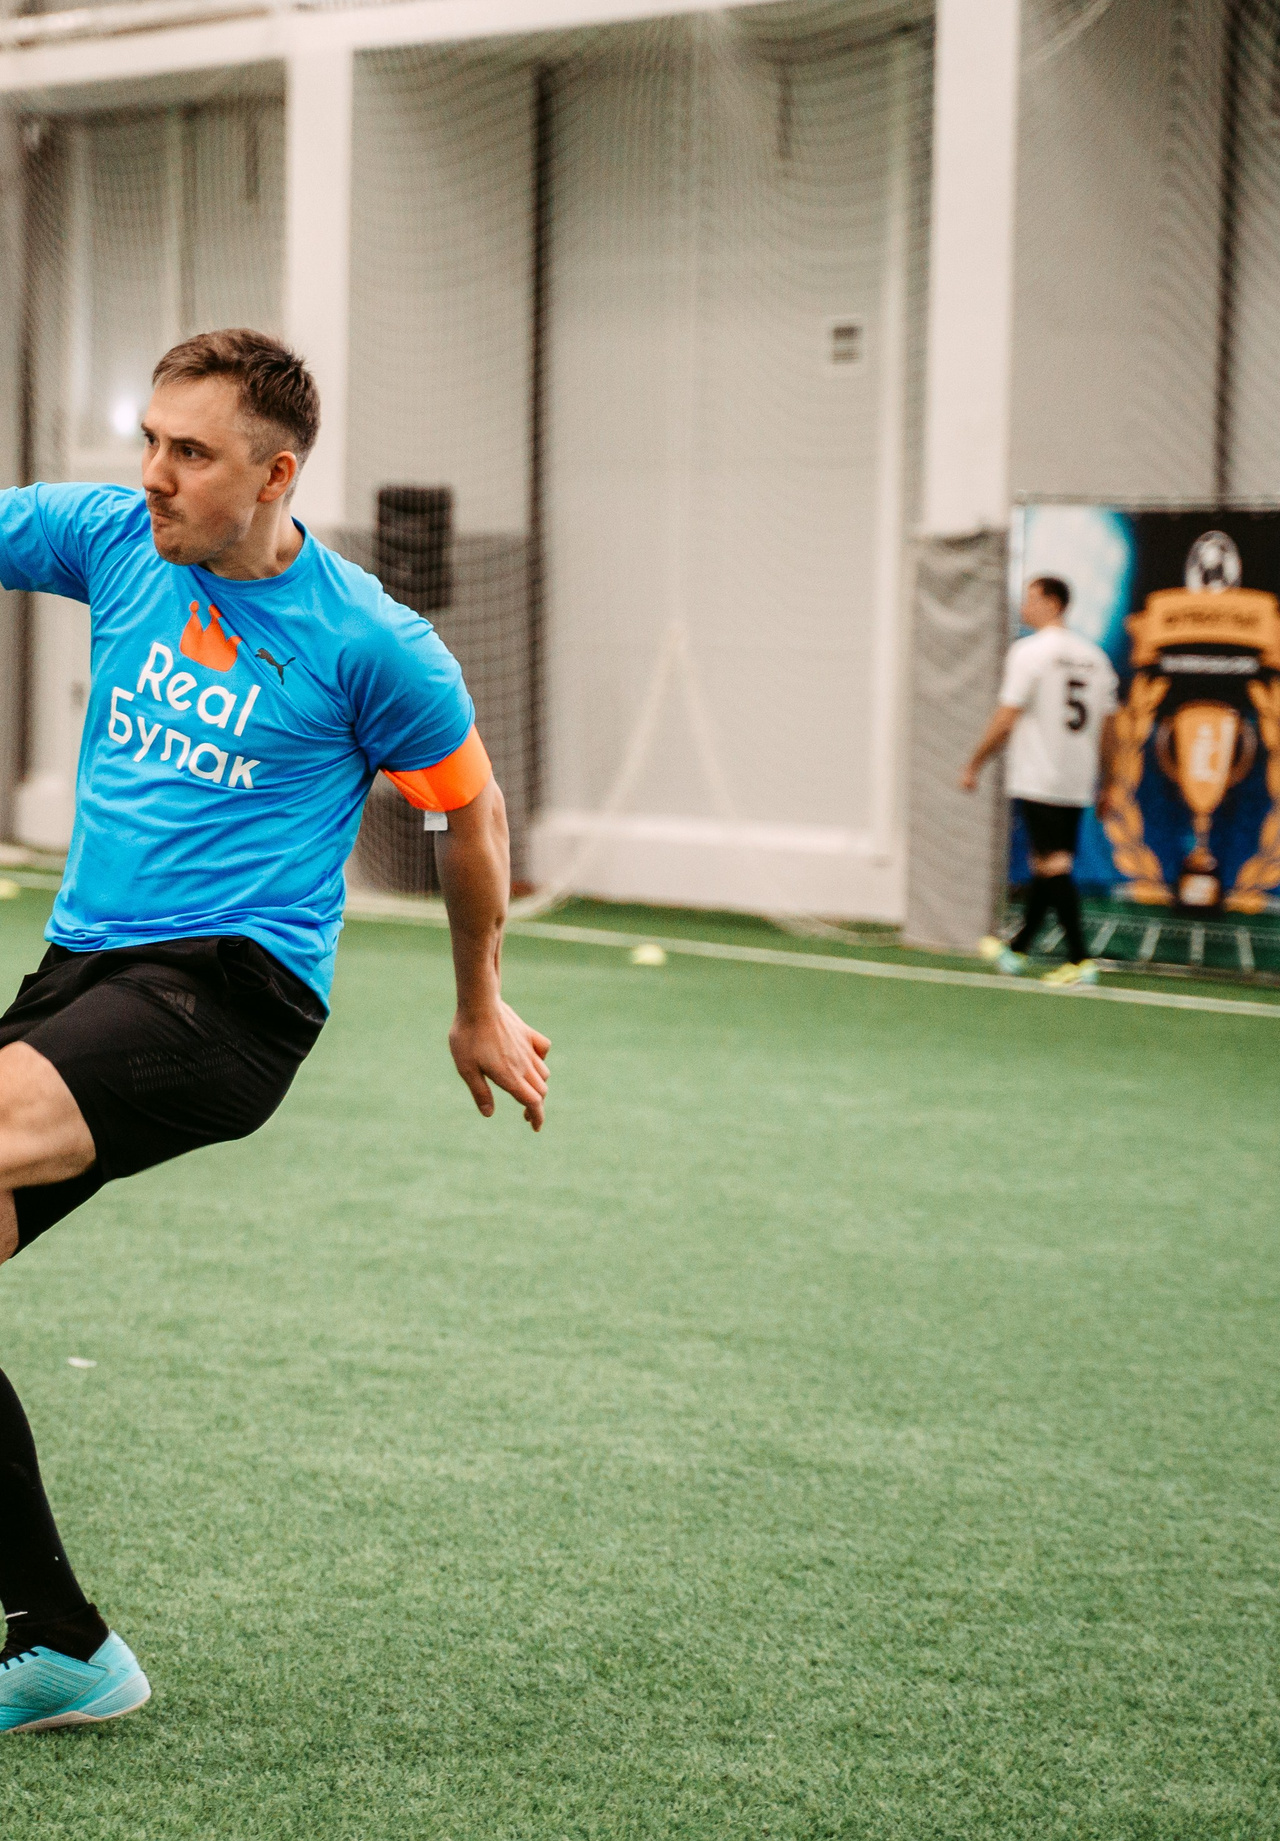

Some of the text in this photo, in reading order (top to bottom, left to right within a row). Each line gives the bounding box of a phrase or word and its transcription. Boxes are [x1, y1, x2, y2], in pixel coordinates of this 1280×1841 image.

[136, 641, 261, 737] Real
[1066, 679, 1088, 731] 5
[108, 686, 261, 789] Булак
